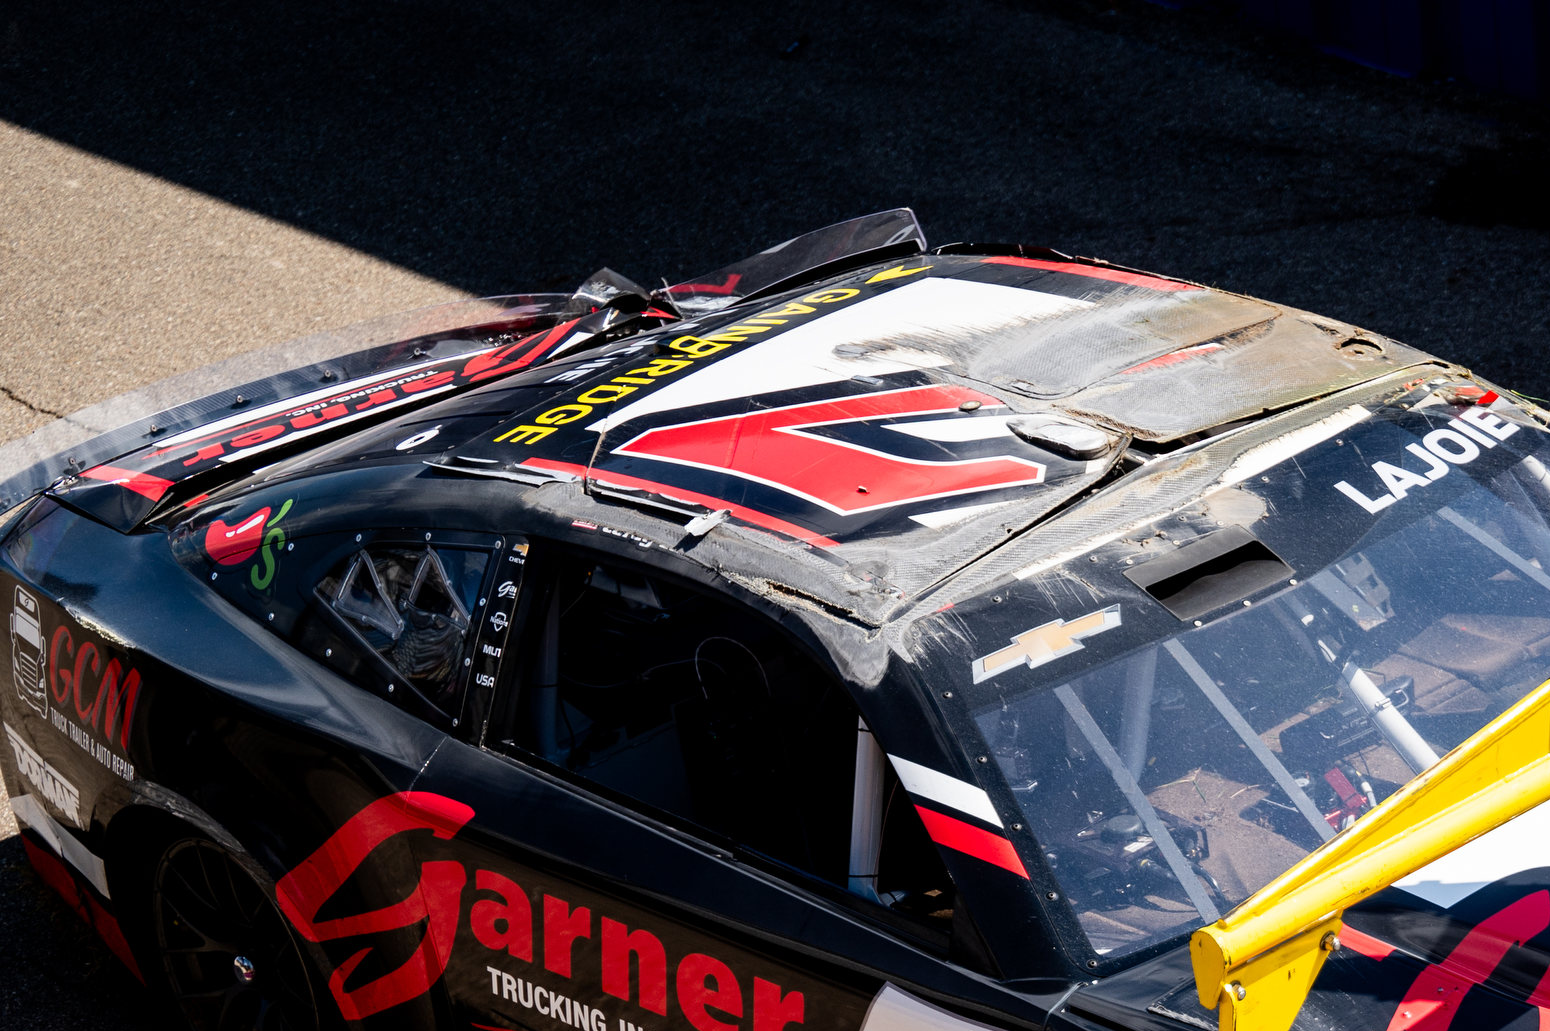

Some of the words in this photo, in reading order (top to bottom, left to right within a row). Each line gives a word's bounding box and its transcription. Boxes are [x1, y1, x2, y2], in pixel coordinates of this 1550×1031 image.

[492, 288, 861, 445] GAINBRIDGE
[1334, 404, 1521, 515] LAJOIE
[50, 624, 143, 751] GCM
[475, 673, 495, 688] USA
[50, 706, 69, 735] TRUCK
[69, 720, 90, 754] TRAILER
[96, 743, 111, 769] AUTO
[112, 754, 135, 782] REPAIR
